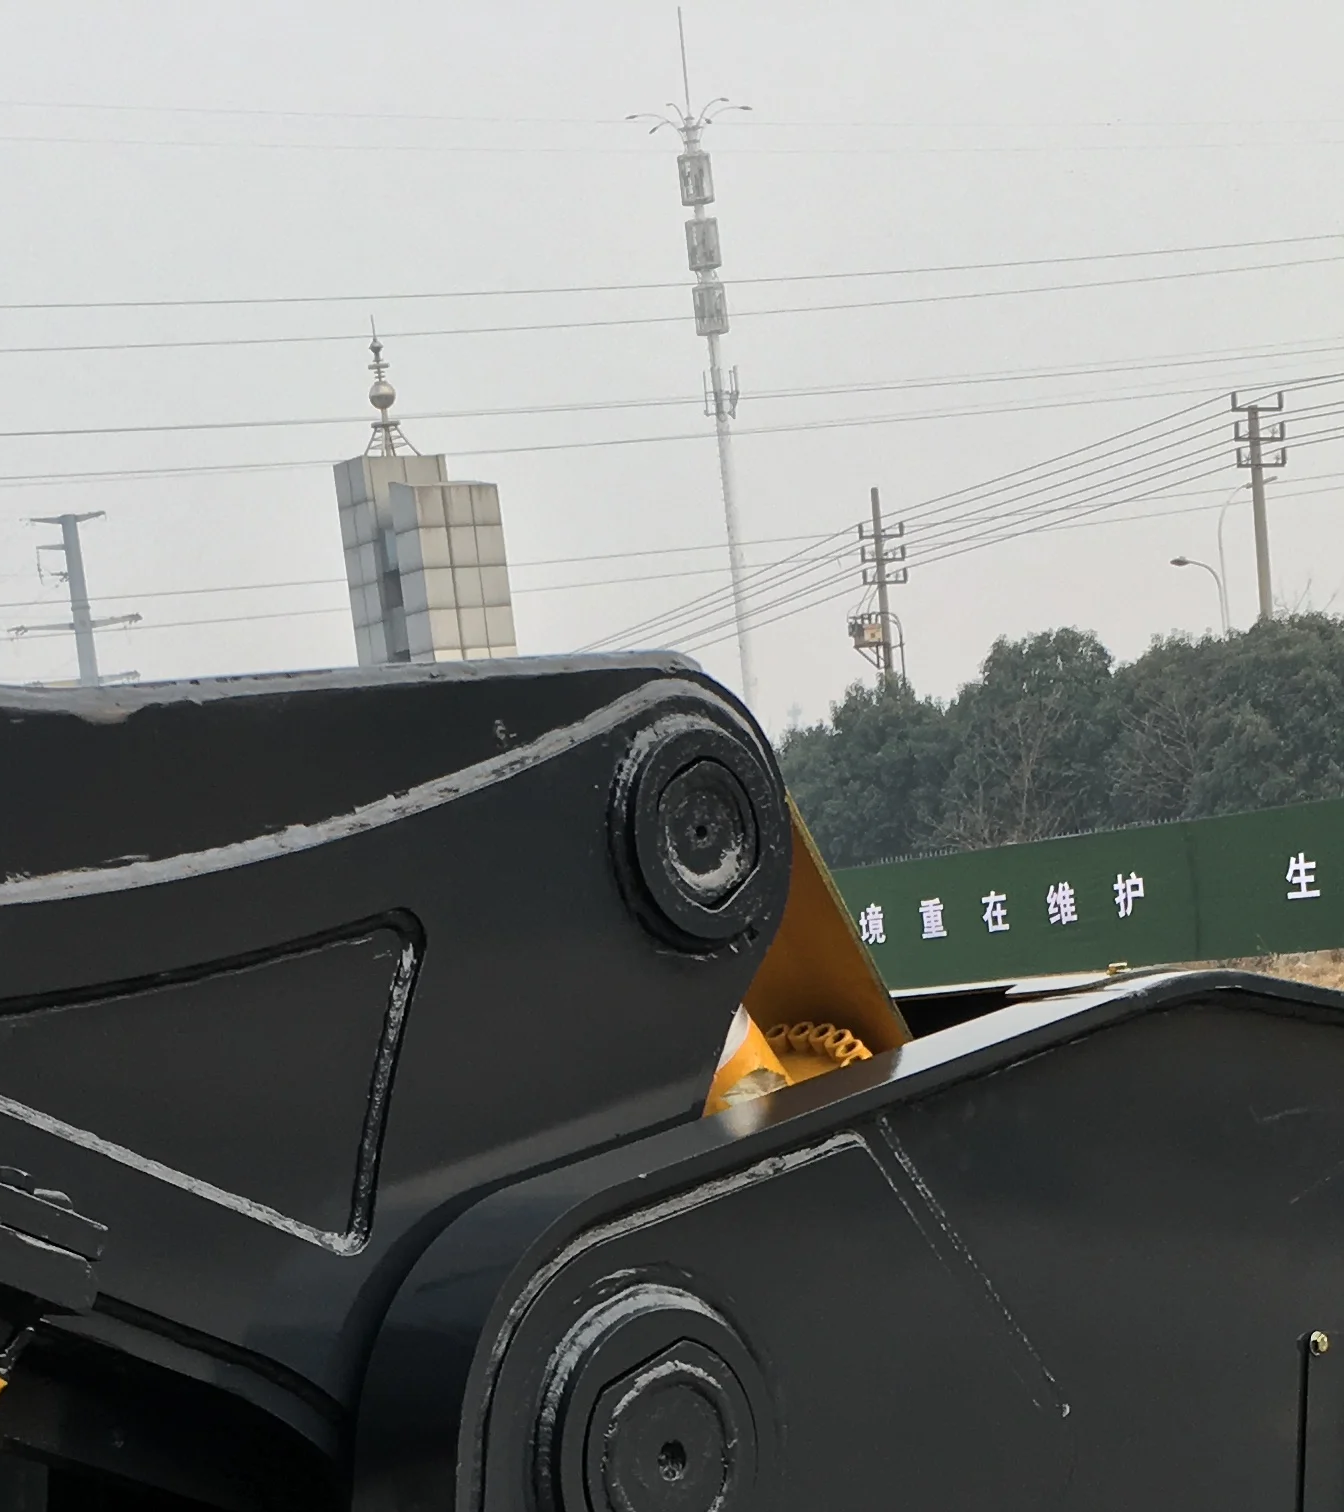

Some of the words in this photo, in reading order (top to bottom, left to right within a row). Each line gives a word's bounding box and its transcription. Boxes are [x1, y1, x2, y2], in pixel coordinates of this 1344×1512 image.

[859, 872, 1145, 945] 境重在维护
